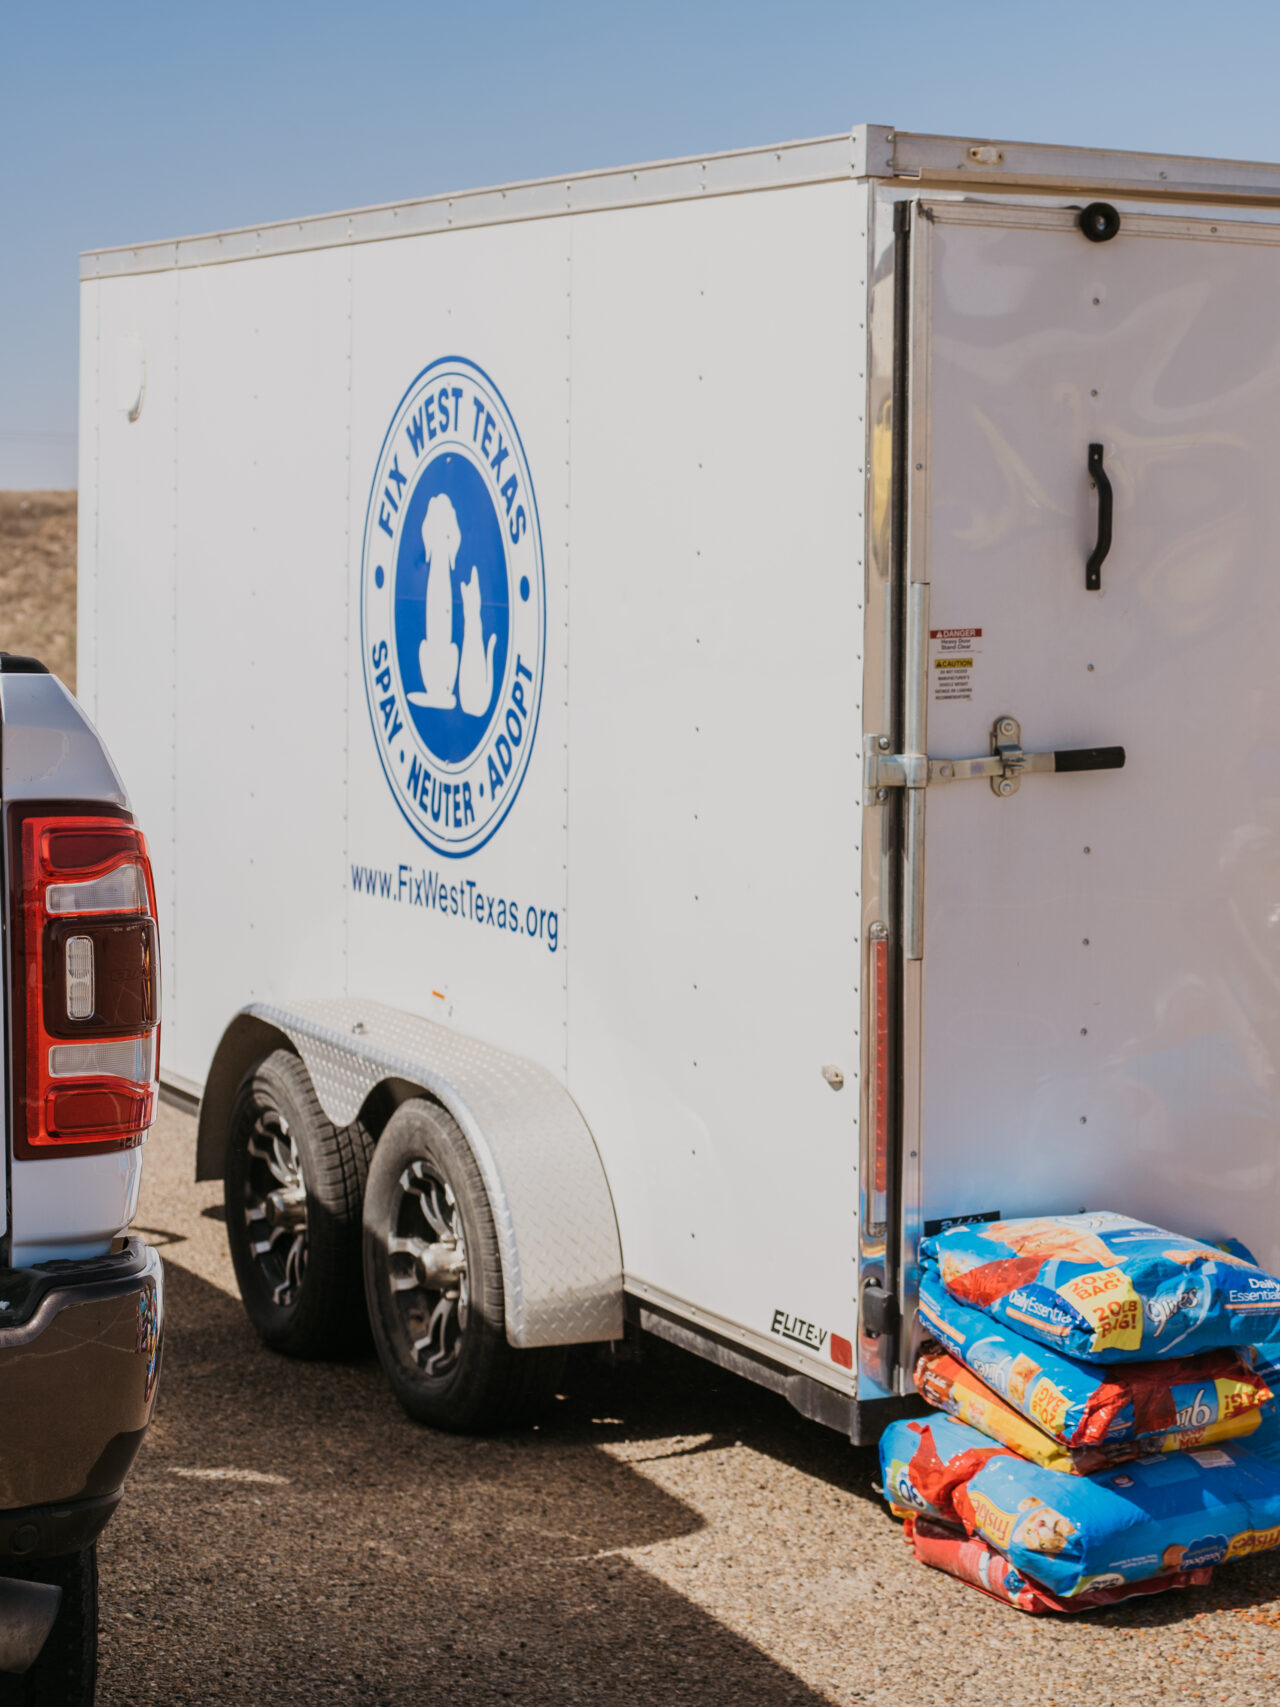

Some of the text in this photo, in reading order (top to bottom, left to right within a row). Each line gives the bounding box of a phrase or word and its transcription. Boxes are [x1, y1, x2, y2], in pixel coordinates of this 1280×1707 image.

[378, 387, 527, 544] FIX WEST TEXAS
[943, 629, 976, 637] DANGER
[372, 640, 533, 828] SPAY NEUTER ADOPT
[351, 863, 558, 952] www.FixWestTexas.org
[1249, 1278, 1280, 1292] Daily
